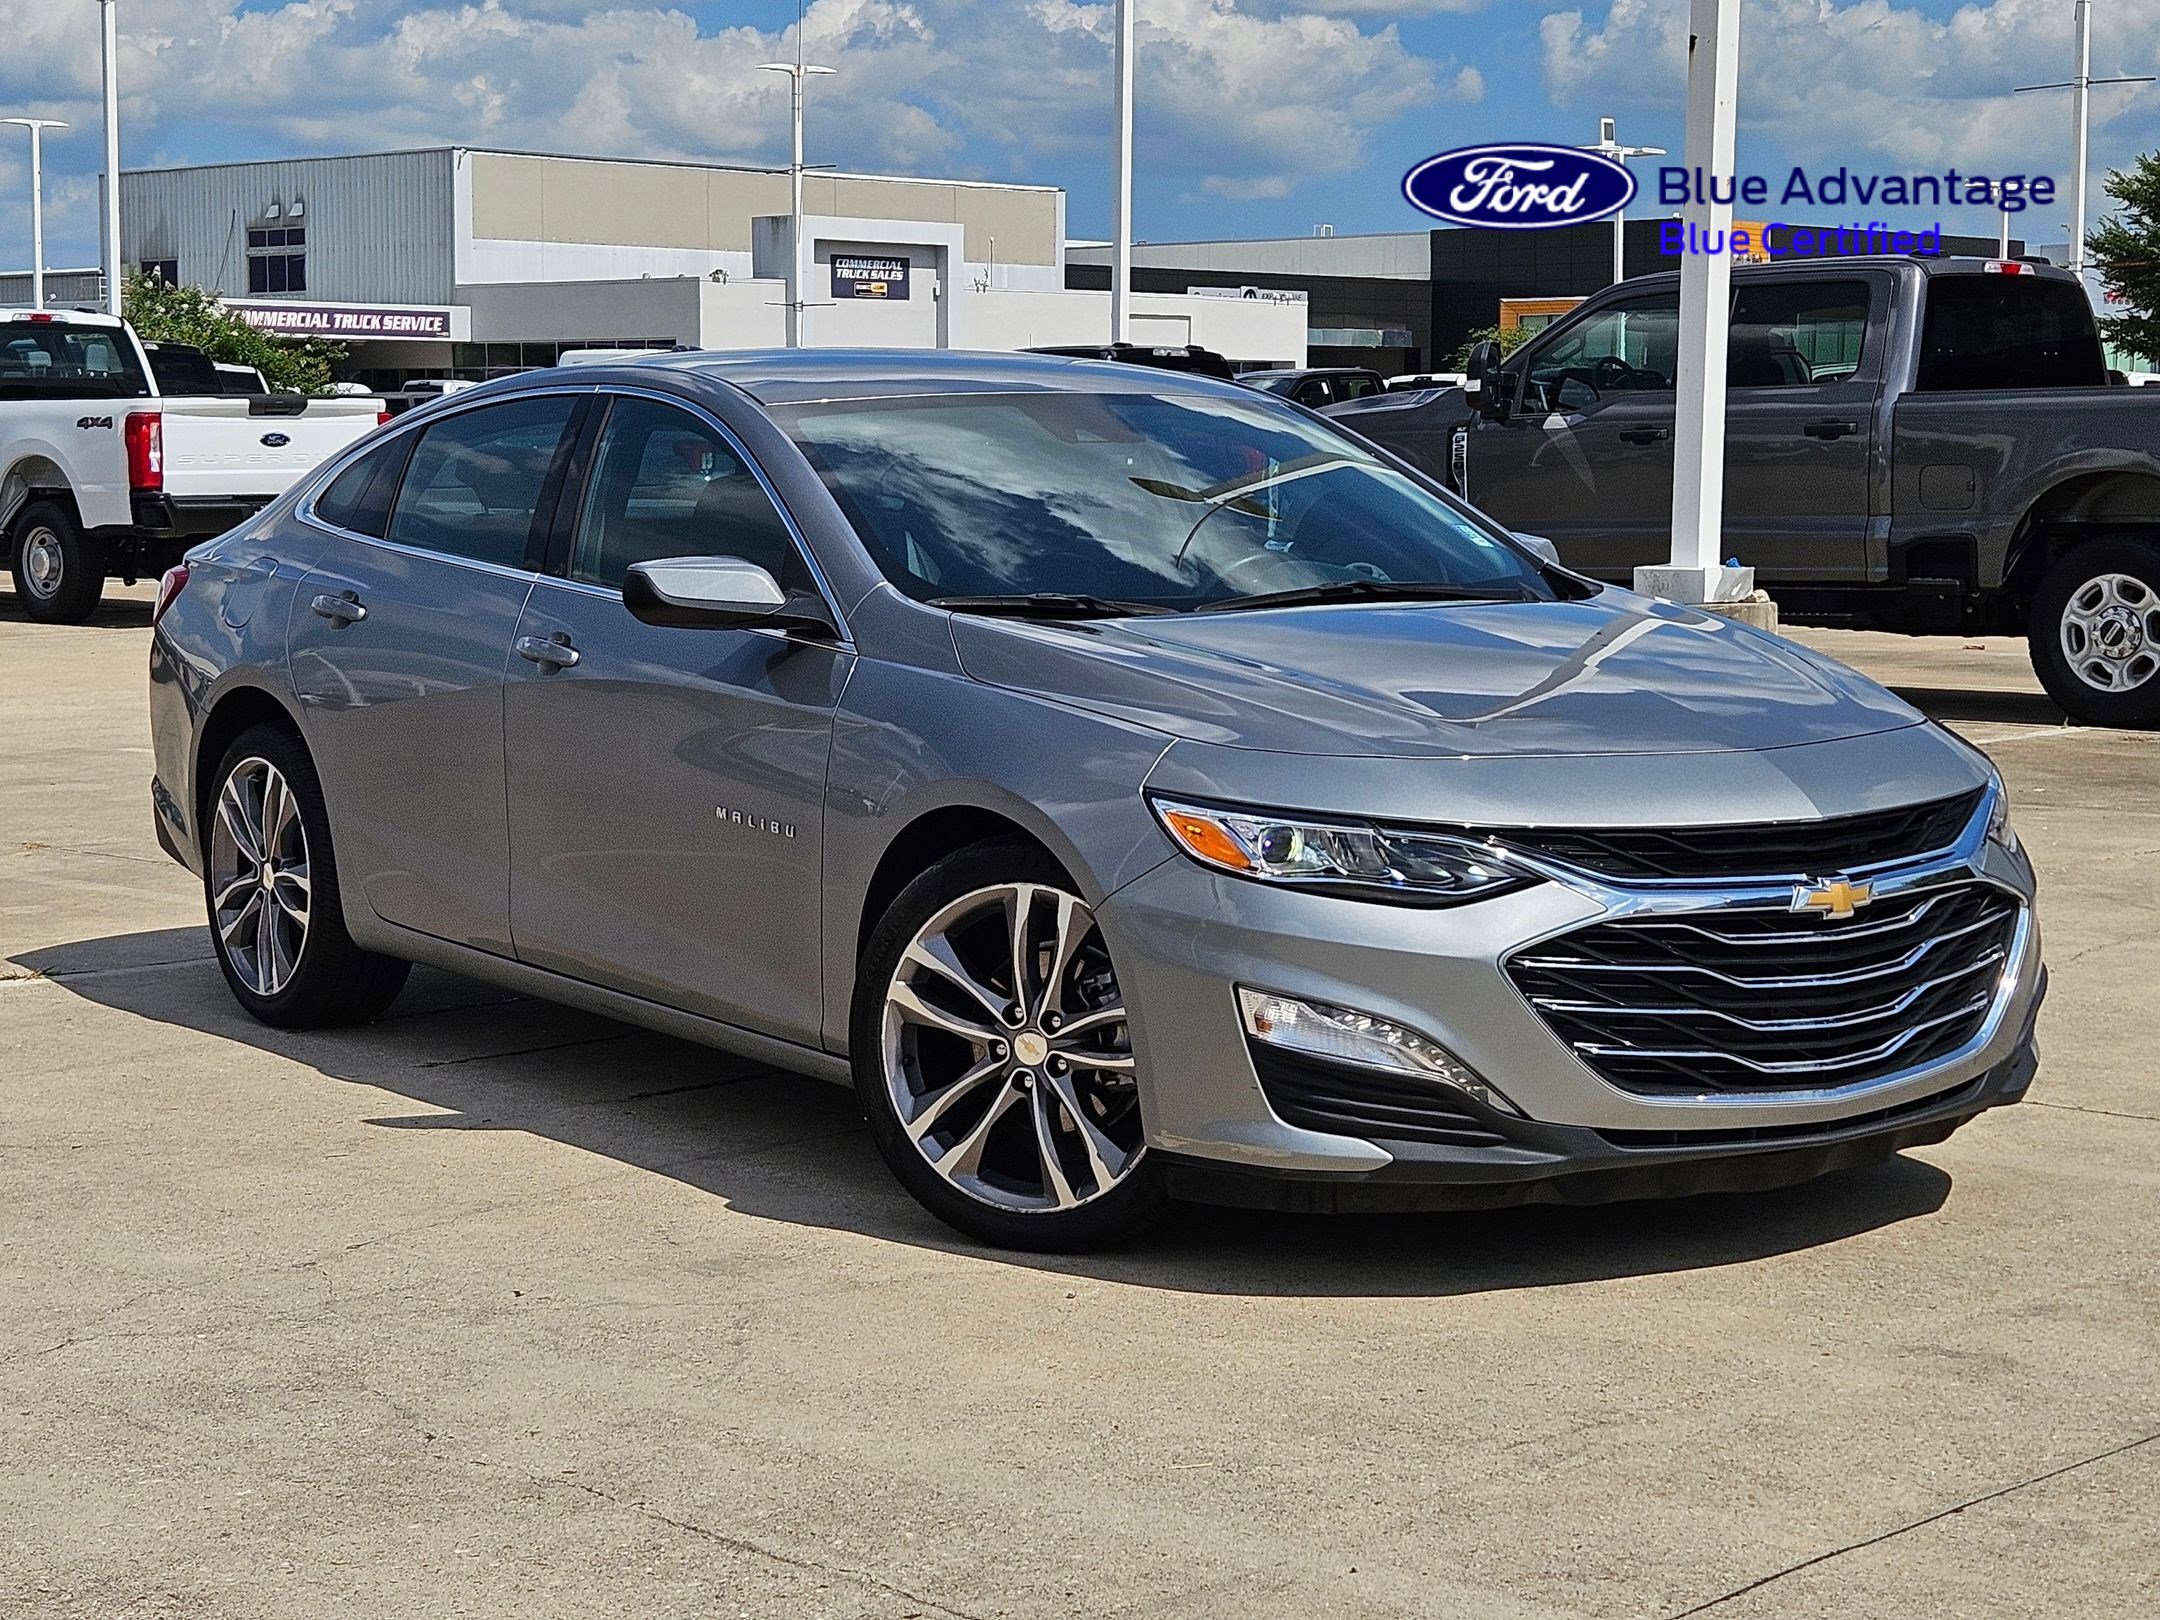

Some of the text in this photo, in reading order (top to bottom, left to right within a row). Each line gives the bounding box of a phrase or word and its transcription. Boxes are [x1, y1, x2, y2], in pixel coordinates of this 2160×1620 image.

[835, 259, 903, 270] COMMERCIAL
[836, 269, 904, 281] TRUCK SALES
[334, 313, 383, 330] TRUCK
[382, 315, 443, 332] SERVICE
[716, 806, 795, 838] MALIBU
